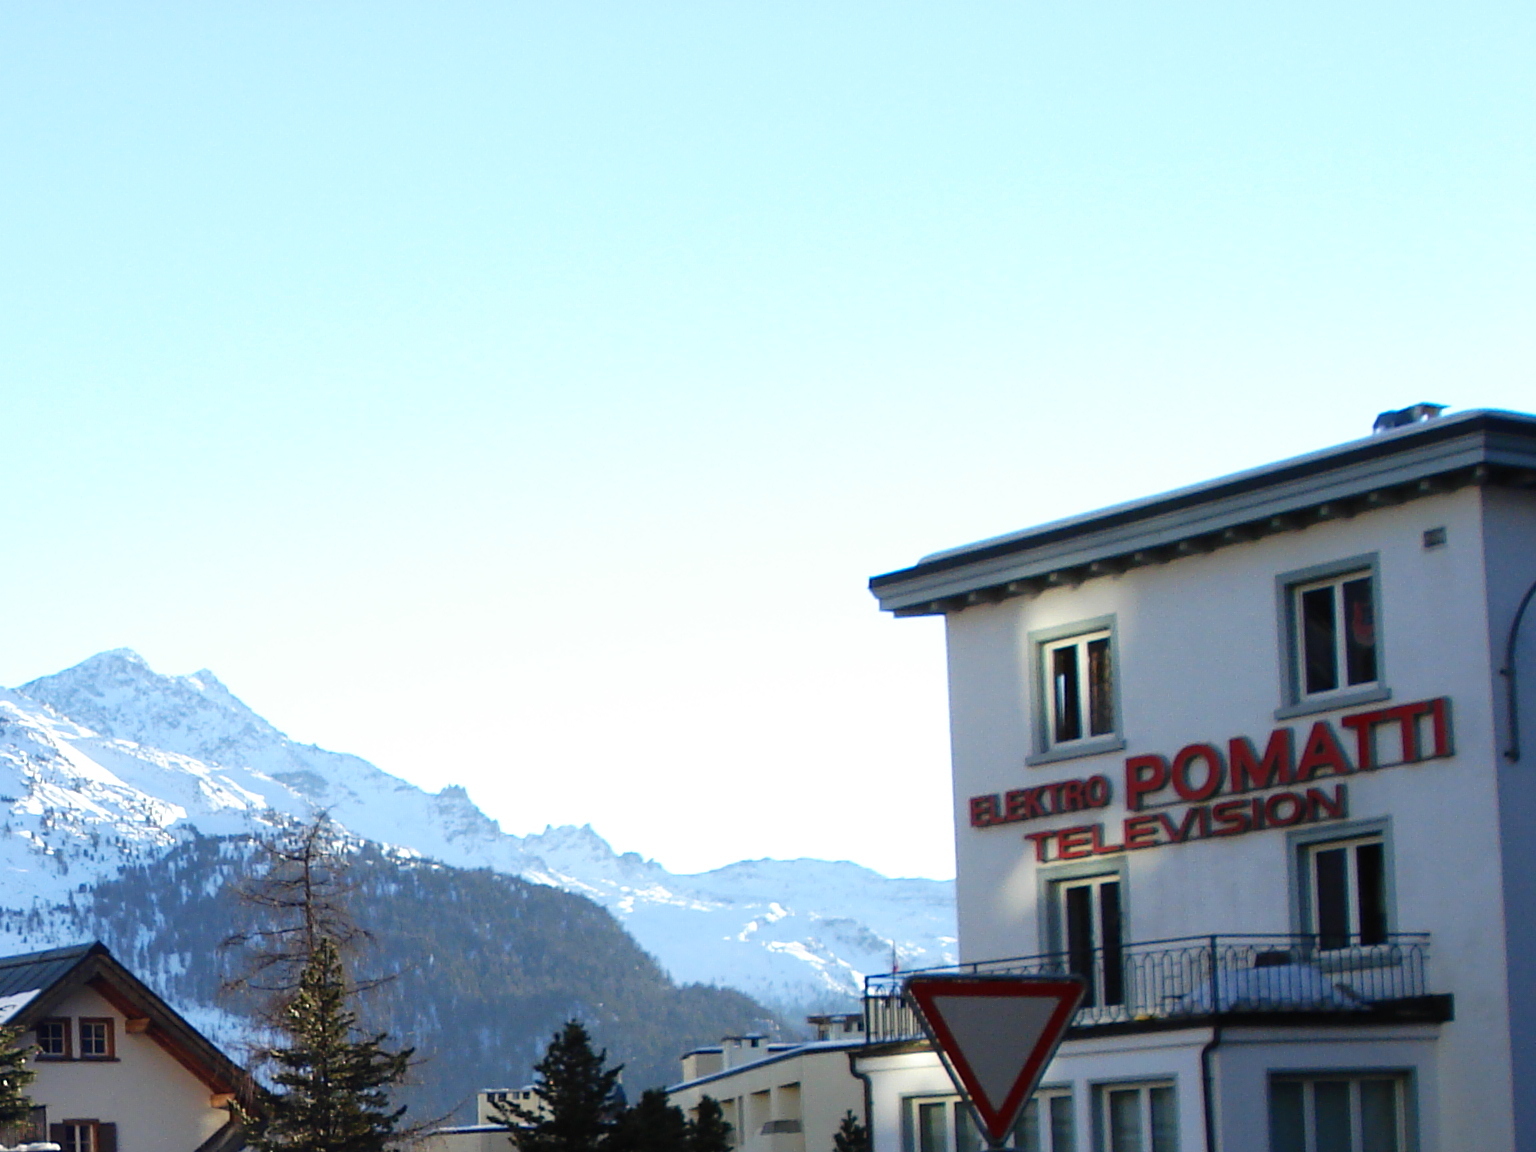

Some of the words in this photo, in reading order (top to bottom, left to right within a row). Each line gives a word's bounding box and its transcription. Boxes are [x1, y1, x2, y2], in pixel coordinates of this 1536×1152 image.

[1123, 696, 1454, 811] POMATTI
[969, 774, 1112, 828] ELEKTRO
[1024, 783, 1348, 863] TELEVISION
